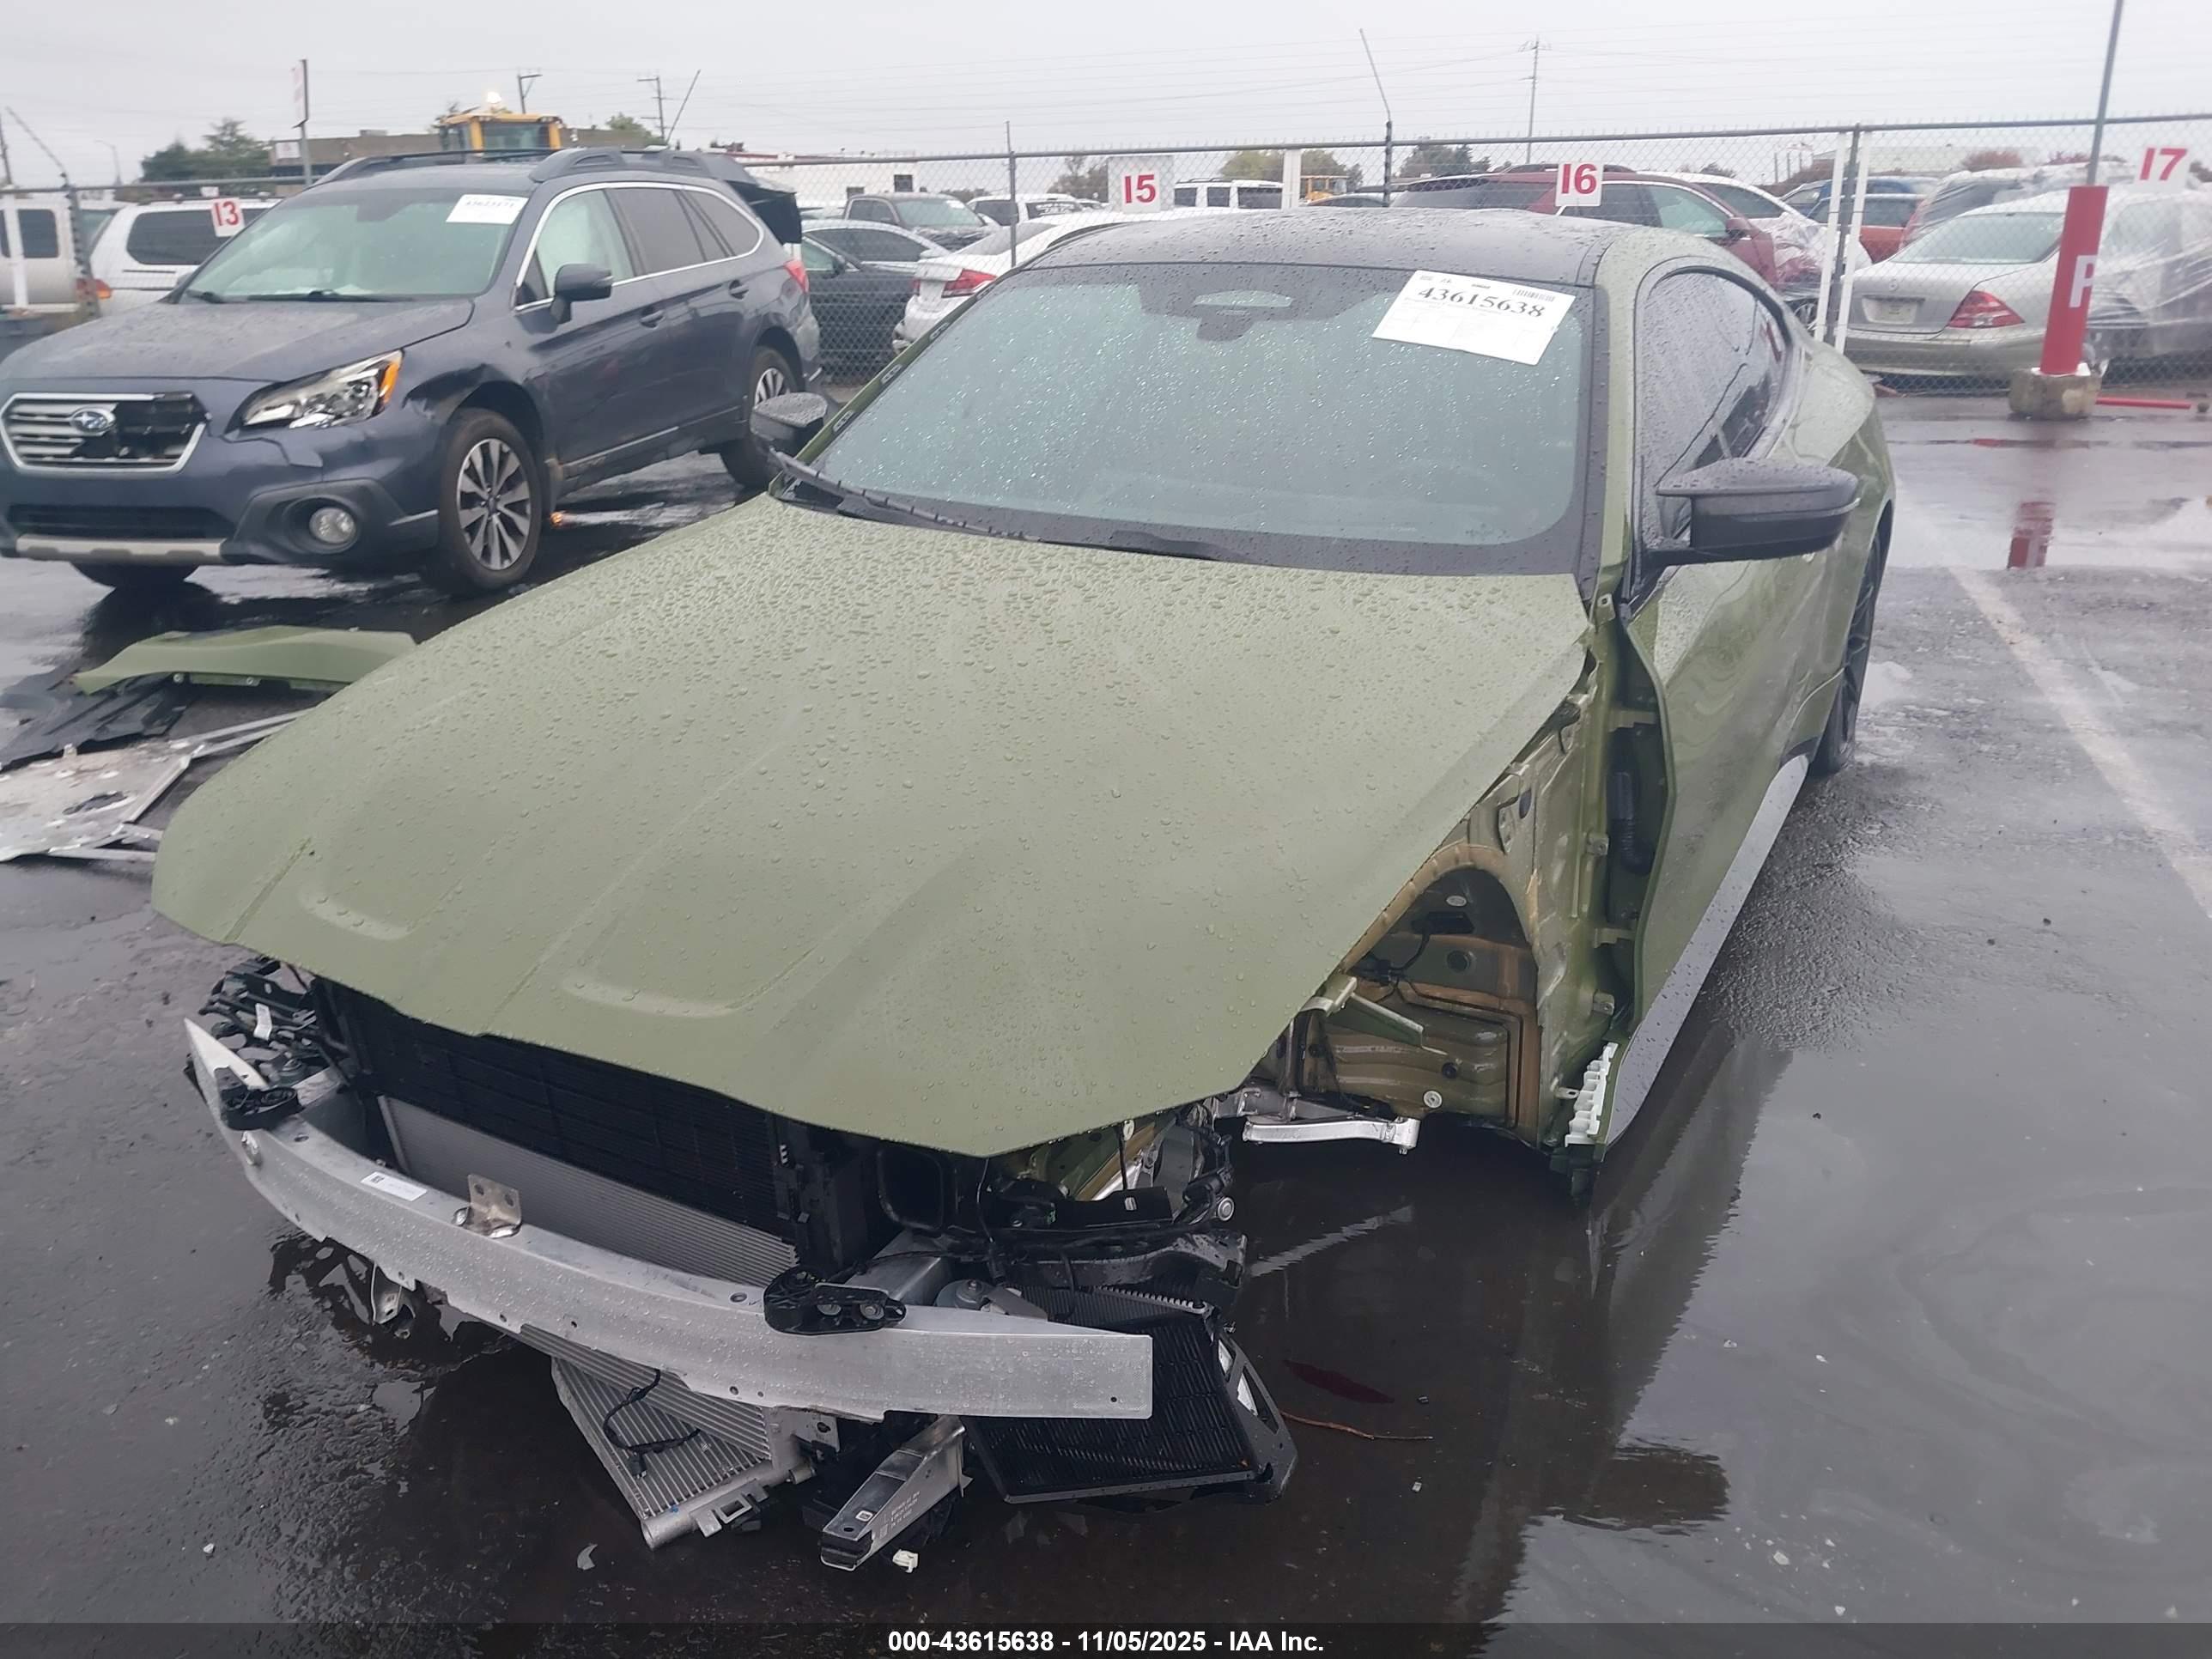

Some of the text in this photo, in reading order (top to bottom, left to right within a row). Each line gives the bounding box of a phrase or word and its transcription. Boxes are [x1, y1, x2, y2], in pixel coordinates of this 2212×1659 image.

[1561, 163, 1597, 194] 16
[2139, 148, 2188, 181] 17
[1125, 174, 1156, 204] 15
[214, 201, 239, 226] 13
[1418, 287, 1546, 318] 43615638
